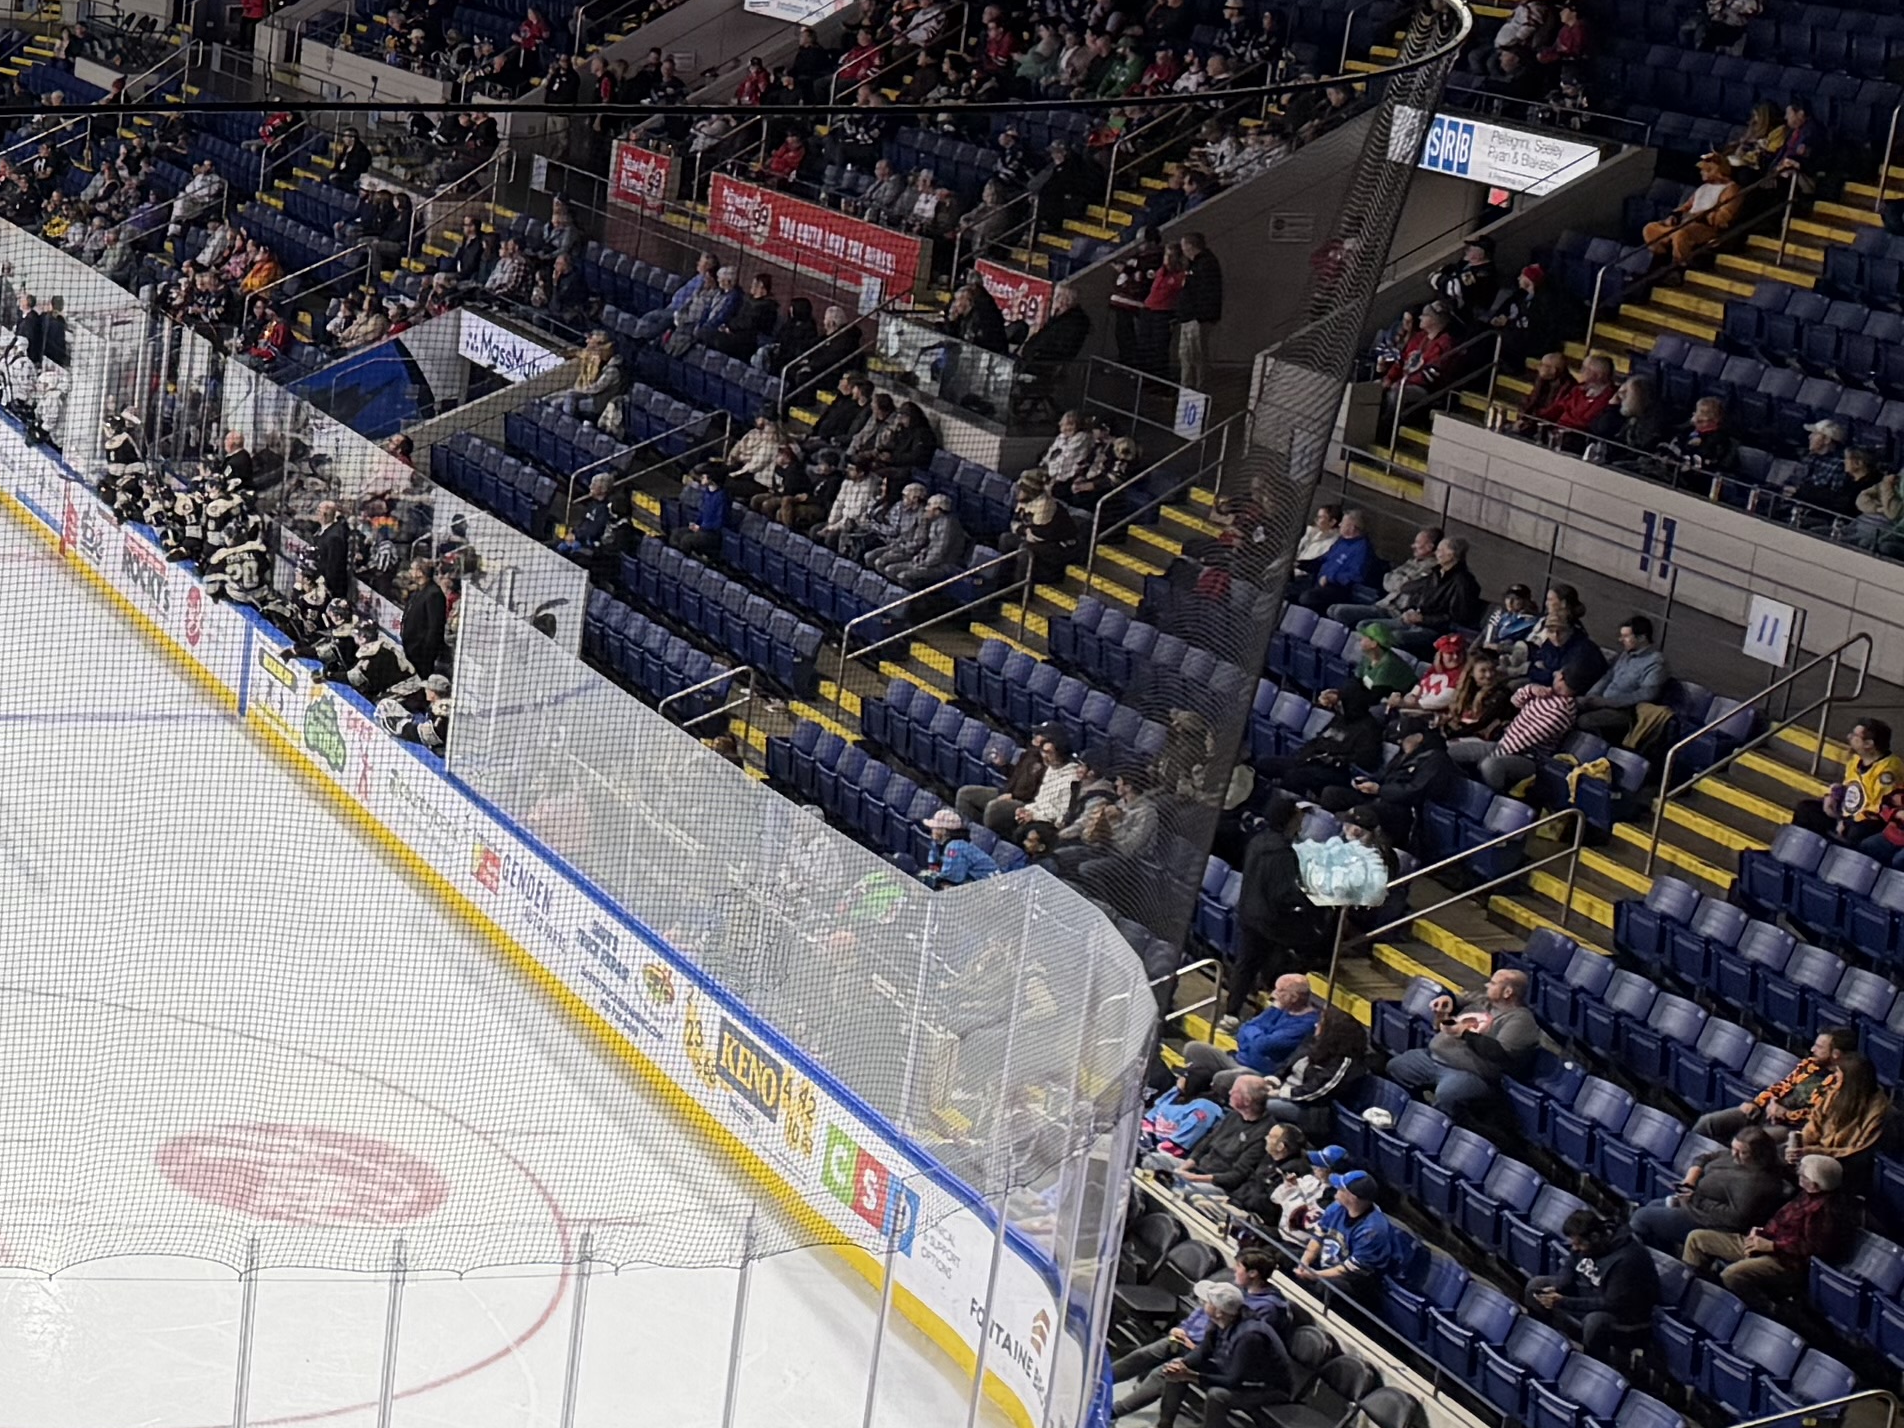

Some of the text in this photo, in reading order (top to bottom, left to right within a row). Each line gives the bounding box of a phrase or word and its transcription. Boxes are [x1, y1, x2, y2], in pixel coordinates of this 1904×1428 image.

[1428, 127, 1471, 164] SRB
[647, 171, 662, 194] 99
[753, 205, 769, 228] 99
[1639, 510, 1677, 579] 11
[1756, 614, 1780, 647] 11
[501, 854, 554, 917] GENDEN
[686, 1019, 703, 1048] 23
[719, 1031, 779, 1109] KENO
[798, 1086, 817, 1123] 42
[920, 1246, 953, 1280] OPTIONS
[969, 1297, 1035, 1378] FOTAINE
